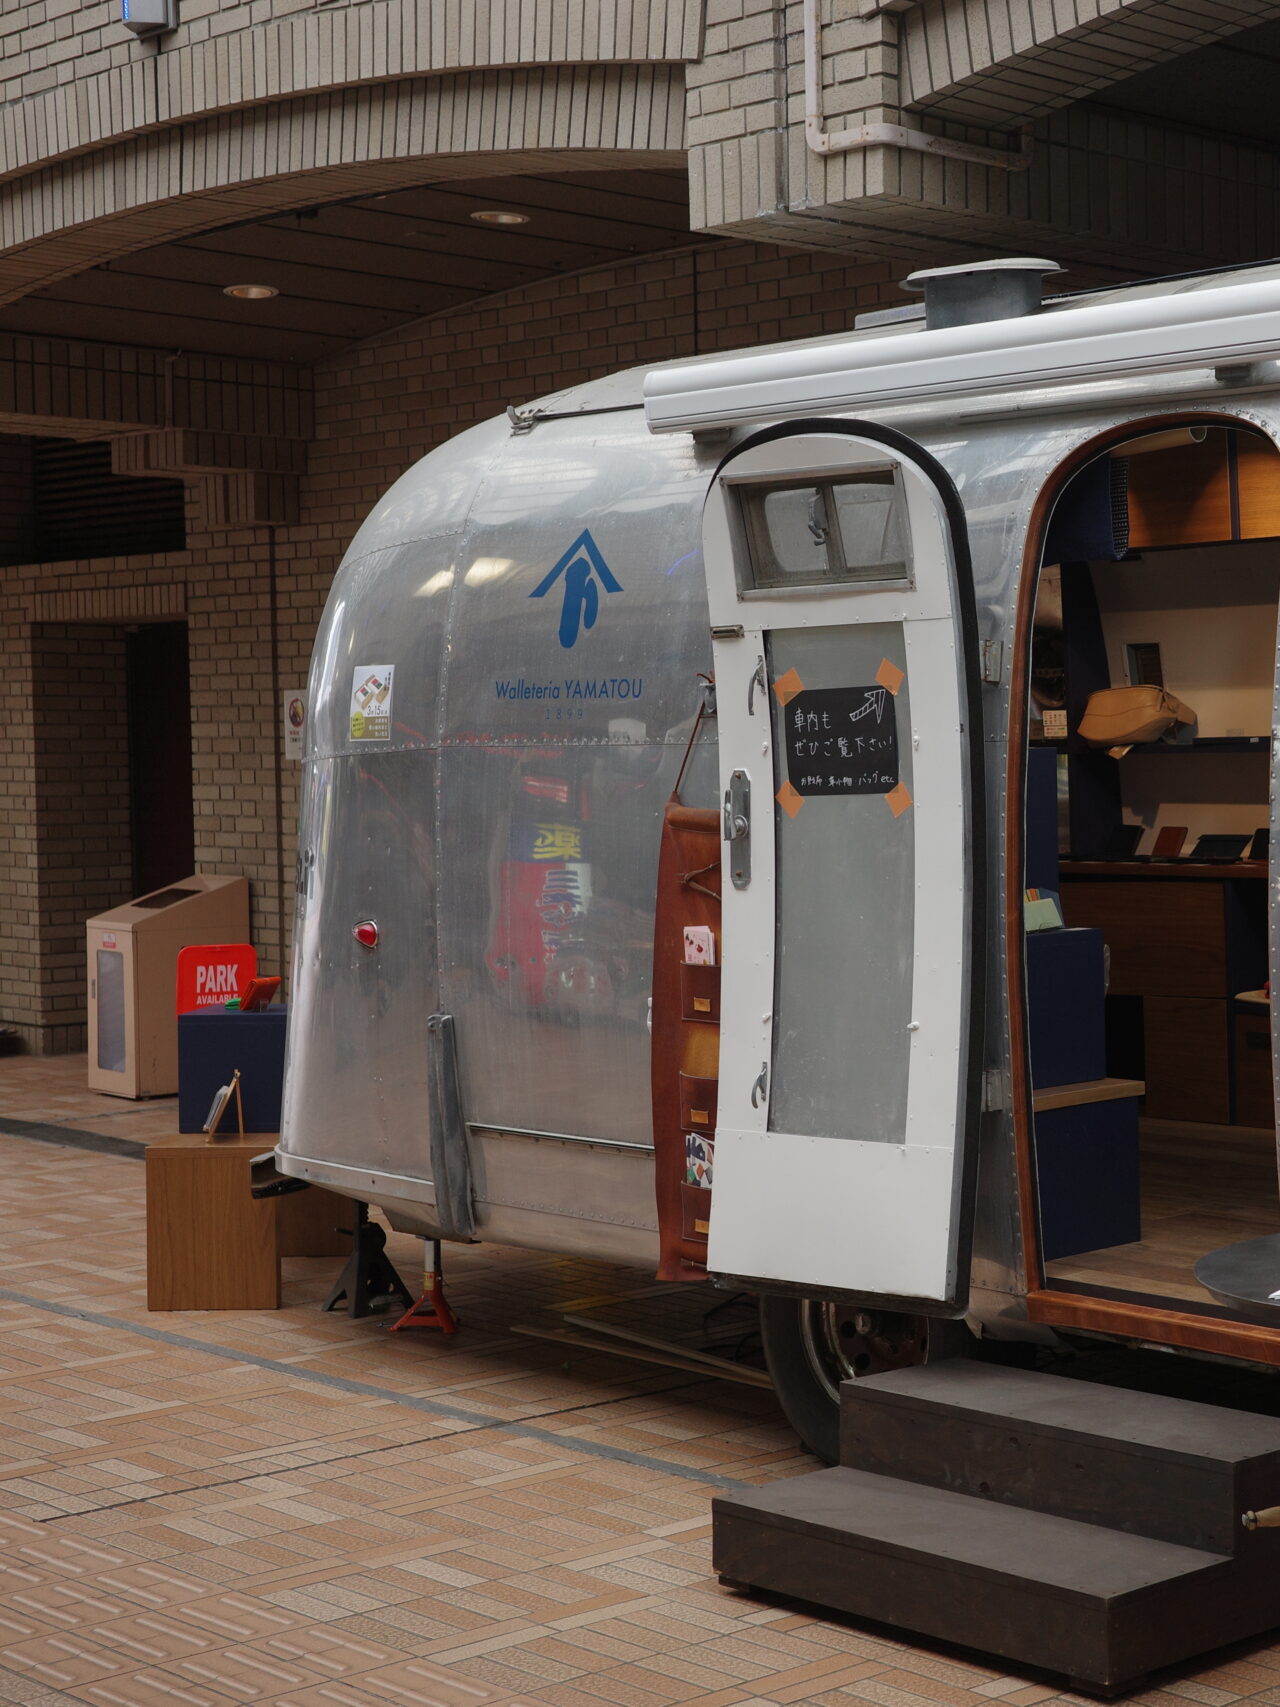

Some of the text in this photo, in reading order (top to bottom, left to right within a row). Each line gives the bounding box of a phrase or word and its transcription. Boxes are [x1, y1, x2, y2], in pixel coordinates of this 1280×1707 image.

[495, 678, 643, 700] Walleteria YAMATOU
[794, 707, 831, 733] 車内も
[196, 964, 239, 993] PARK
